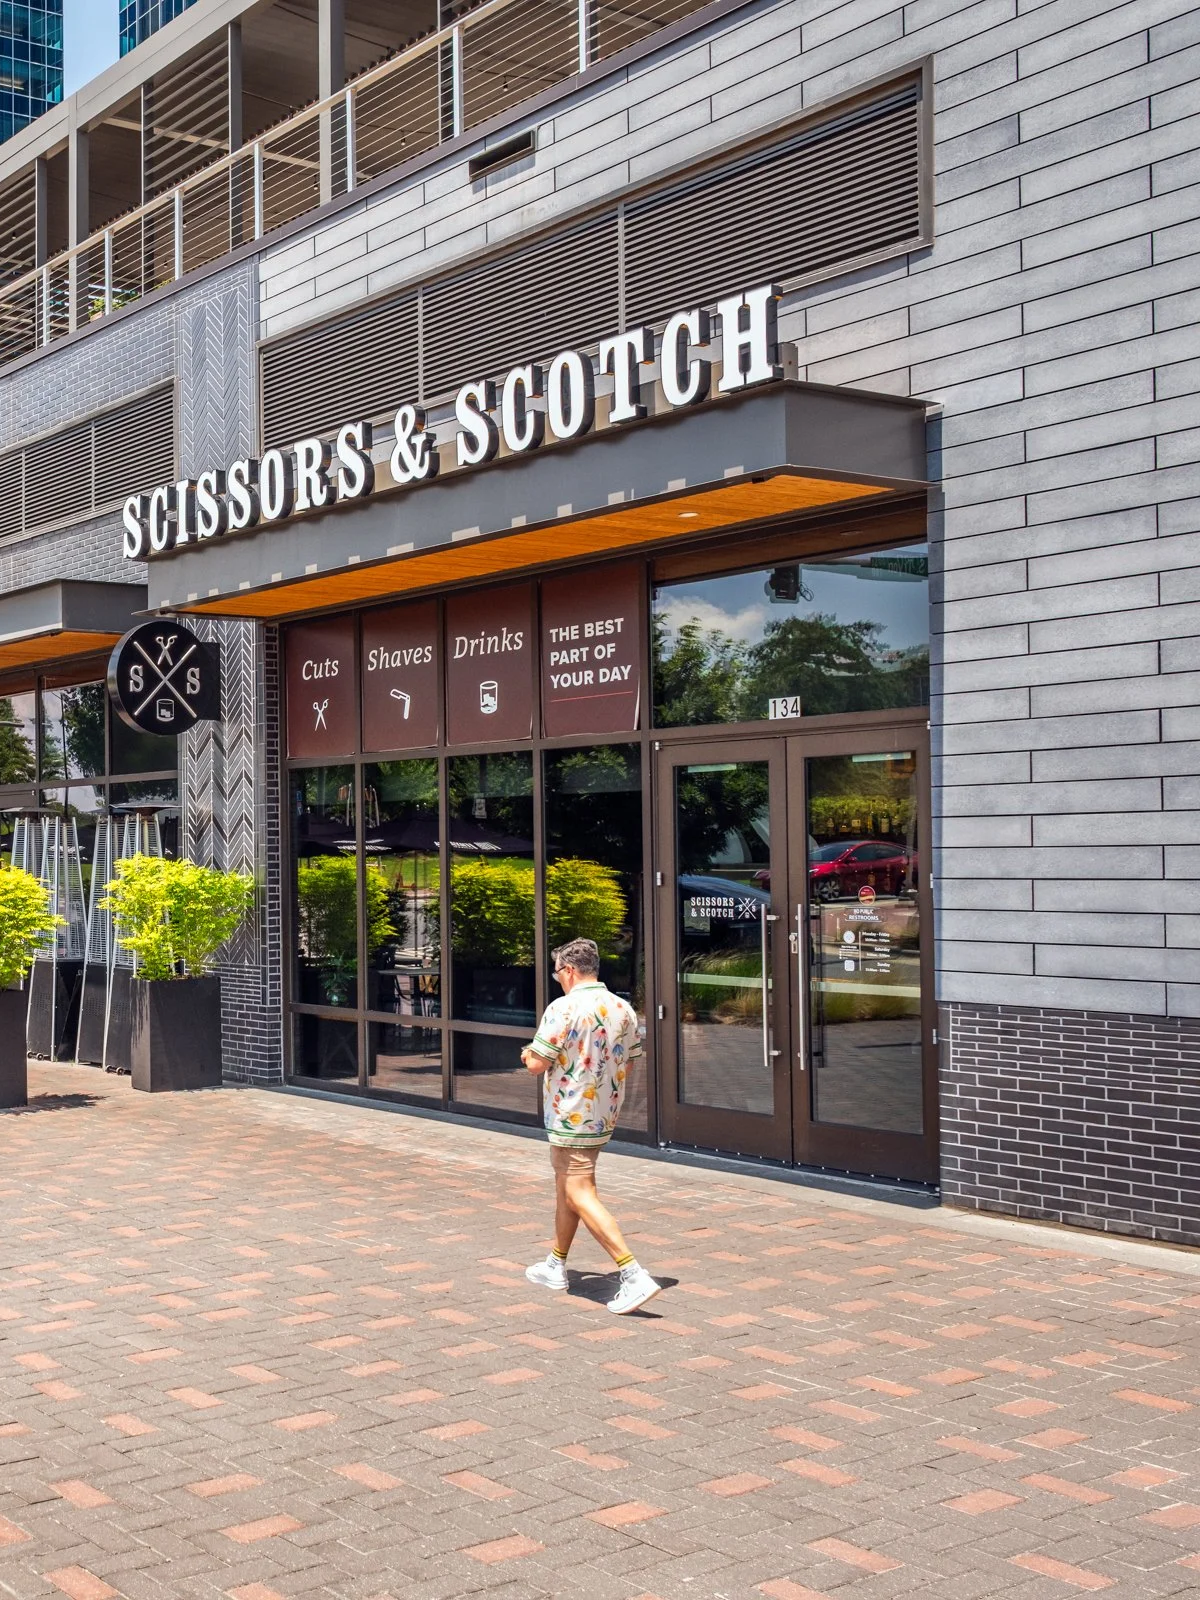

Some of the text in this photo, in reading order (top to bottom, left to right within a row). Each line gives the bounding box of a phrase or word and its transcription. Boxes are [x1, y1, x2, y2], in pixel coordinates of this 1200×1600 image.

[123, 284, 780, 559] SCISSORS & SCOTCH
[550, 617, 624, 643] THE BEST
[453, 627, 524, 659] Drinks
[550, 643, 616, 666] PART OF
[302, 659, 339, 681] Cuts
[367, 645, 433, 671] Shaves
[129, 665, 200, 694] S S
[550, 665, 632, 689] YOUR DAY
[772, 697, 799, 718] 134
[690, 897, 734, 907] SCISSORS
[691, 908, 734, 918] & SCOTCH
